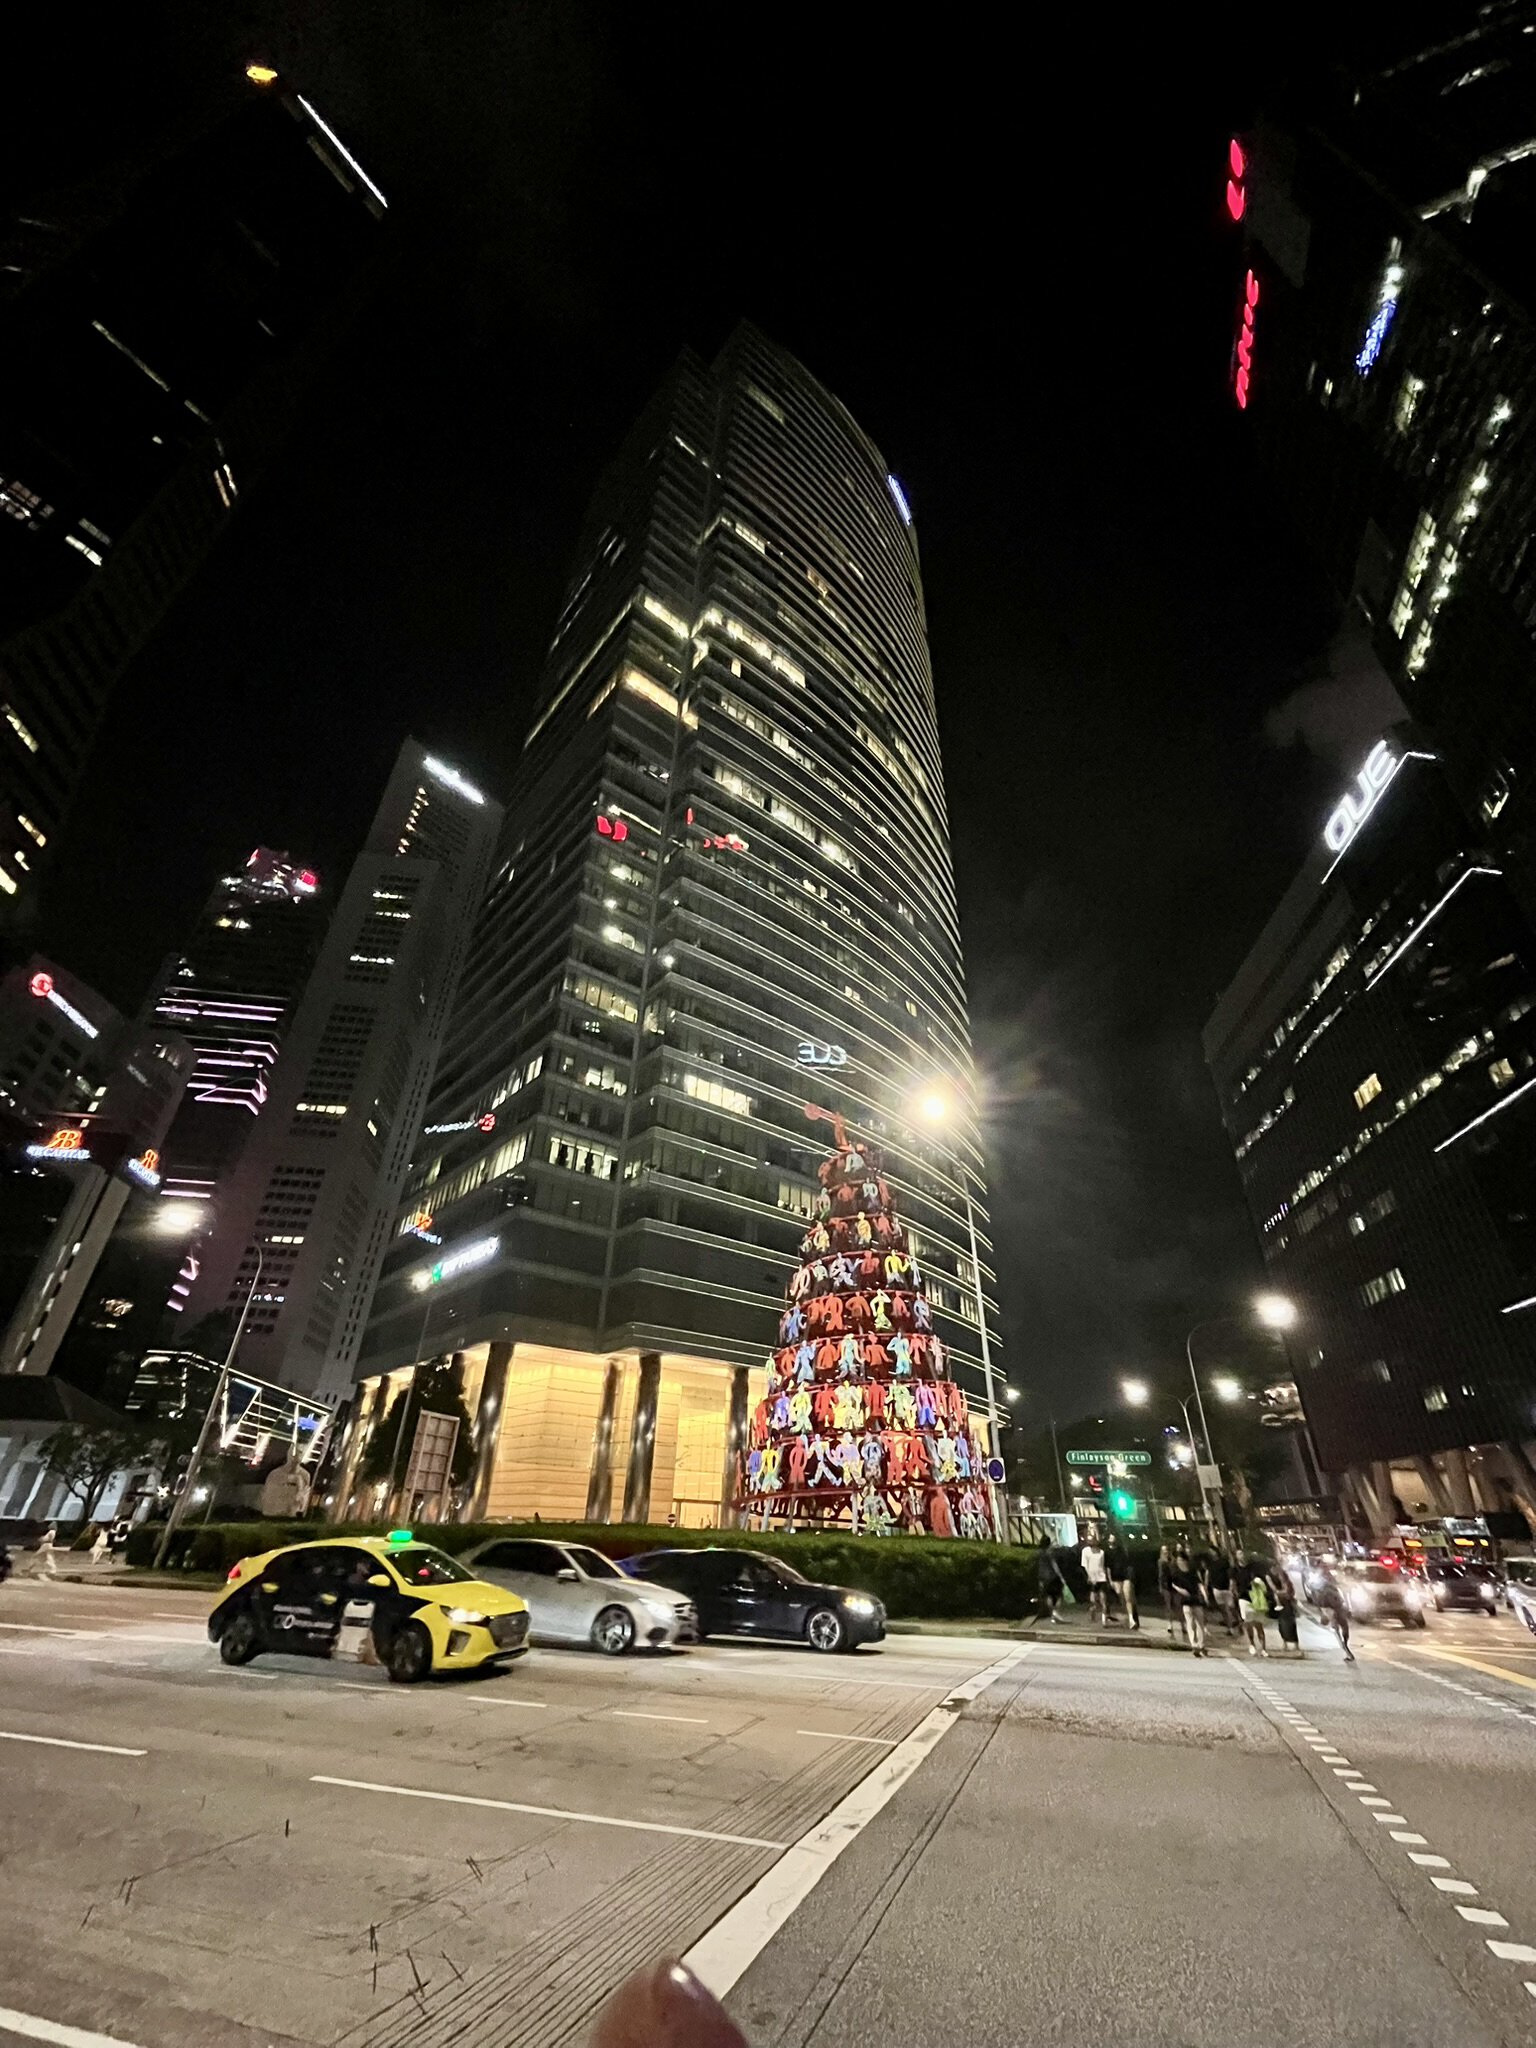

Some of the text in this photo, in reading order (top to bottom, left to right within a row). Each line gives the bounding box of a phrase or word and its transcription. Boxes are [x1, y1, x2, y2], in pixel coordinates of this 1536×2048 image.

[1324, 740, 1397, 850] OUE
[1071, 1453, 1146, 1462] Finlayson Green
